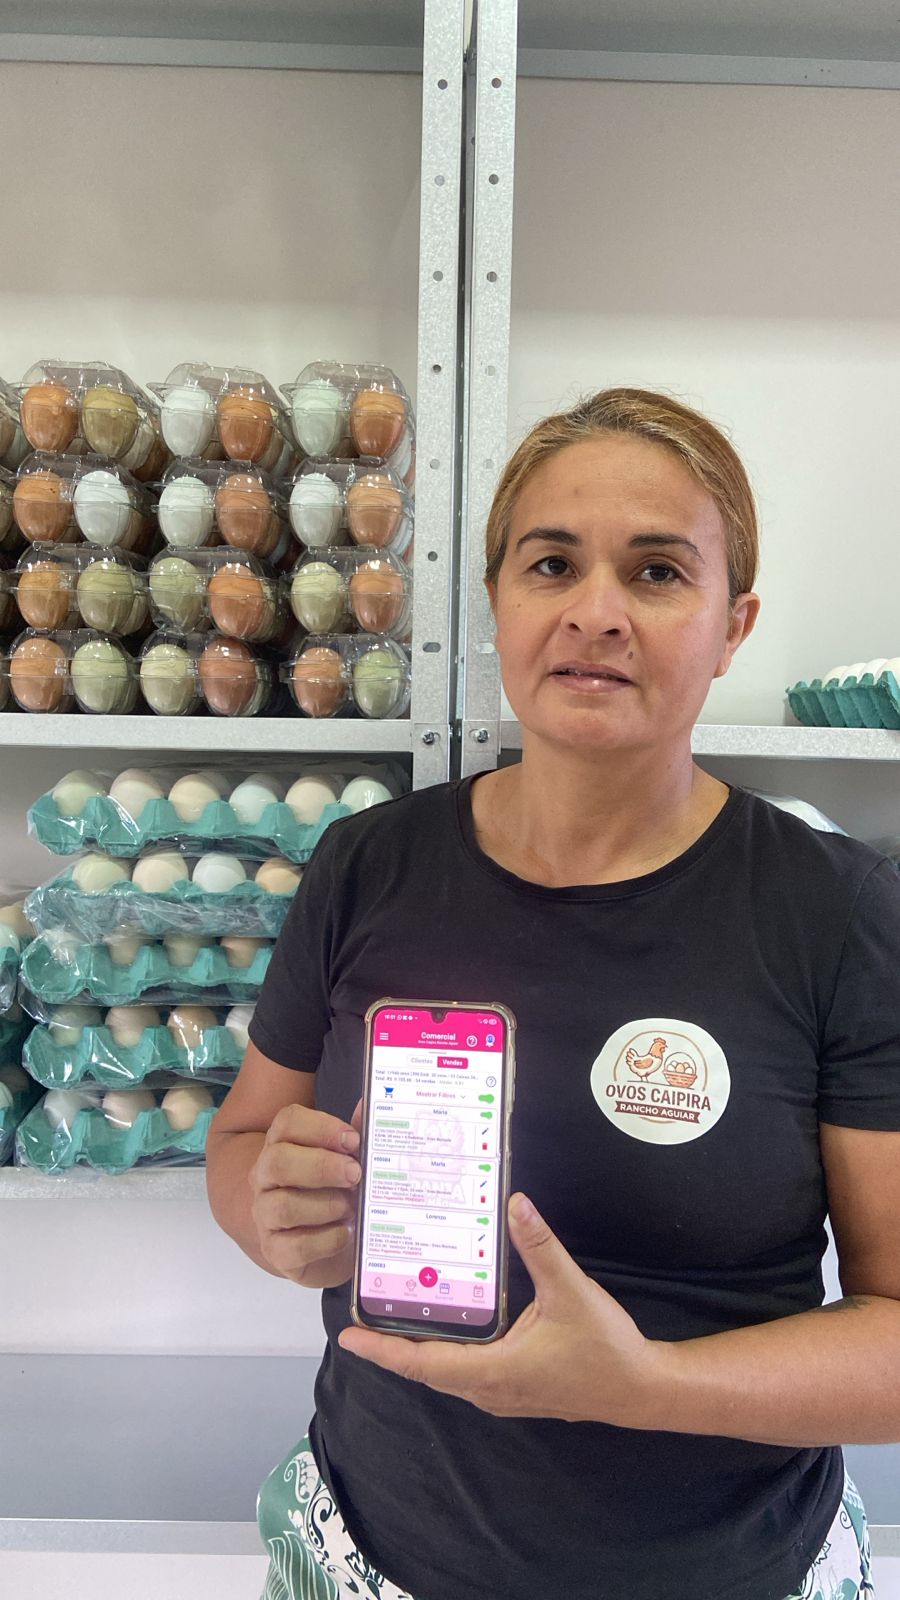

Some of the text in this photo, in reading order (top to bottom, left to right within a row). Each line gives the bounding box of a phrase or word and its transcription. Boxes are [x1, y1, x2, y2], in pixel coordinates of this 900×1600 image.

[421, 1032, 456, 1041] Comercial
[442, 1058, 463, 1066] Vendas
[606, 1084, 711, 1111] OVOS CAIPIRA
[620, 1103, 695, 1120] RANCHO AGUIAR
